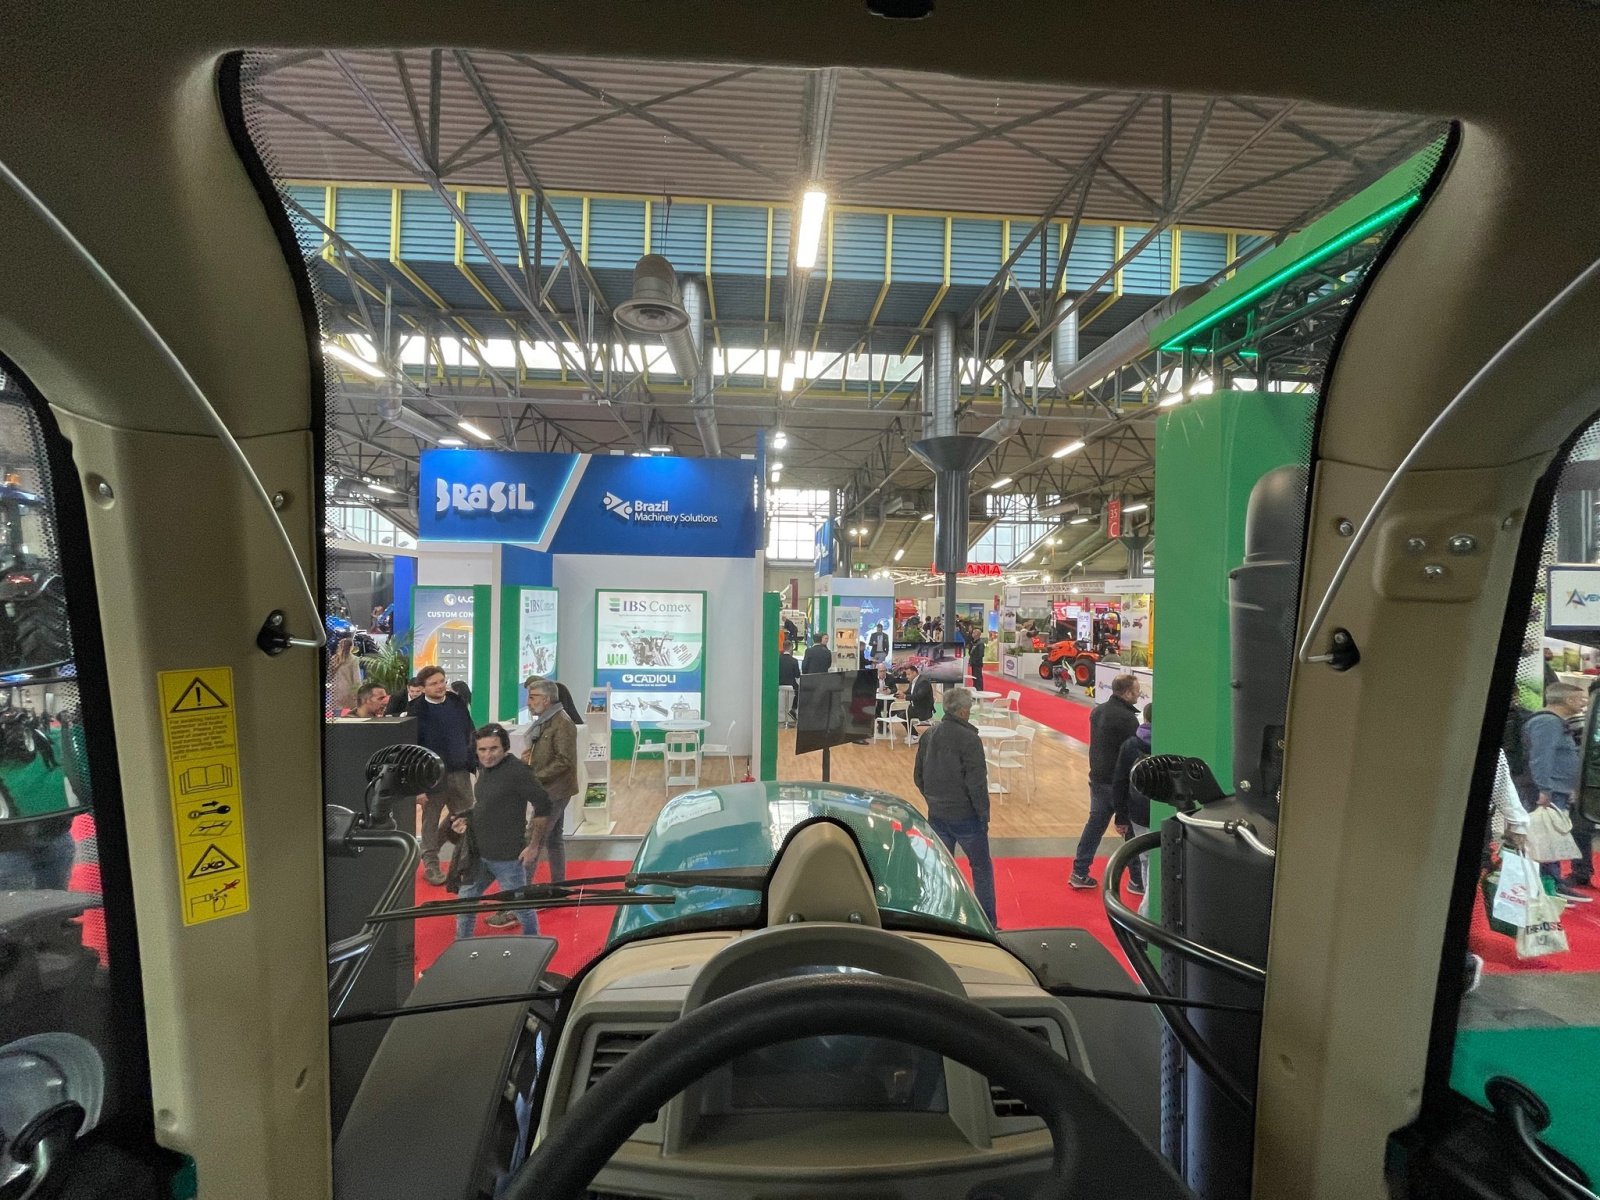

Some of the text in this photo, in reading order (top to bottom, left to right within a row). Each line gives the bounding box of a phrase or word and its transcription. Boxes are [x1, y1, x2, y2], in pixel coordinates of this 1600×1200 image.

[634, 500, 669, 512] Brazil
[634, 512, 718, 524] Machinery Solutions
[623, 600, 692, 612] IBS Comex
[634, 674, 676, 684] CADIOLI
